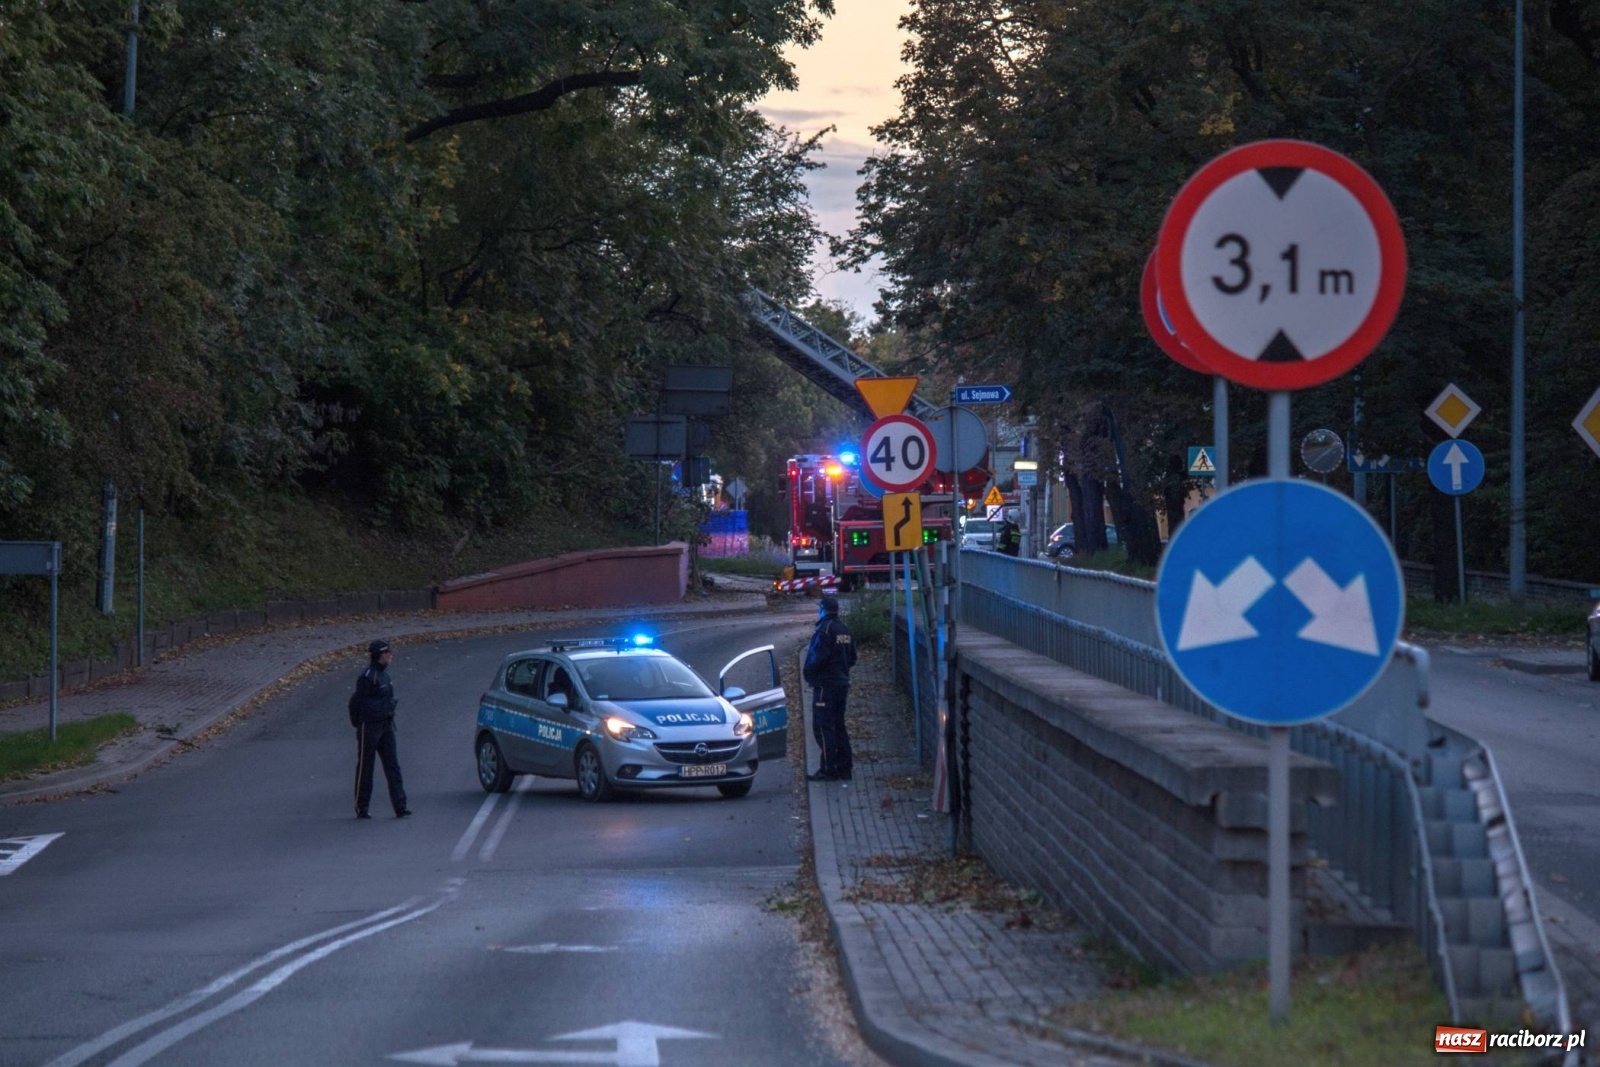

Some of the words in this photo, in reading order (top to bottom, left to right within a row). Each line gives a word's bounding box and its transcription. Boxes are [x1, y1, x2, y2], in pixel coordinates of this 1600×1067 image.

[1211, 232, 1300, 304] 3,1
[1318, 268, 1354, 295] m
[960, 391, 970, 400] ul.
[971, 390, 999, 401] Sejmowa
[869, 435, 926, 472] 40
[655, 713, 721, 725] POLICJA
[538, 724, 562, 742] POLICJA
